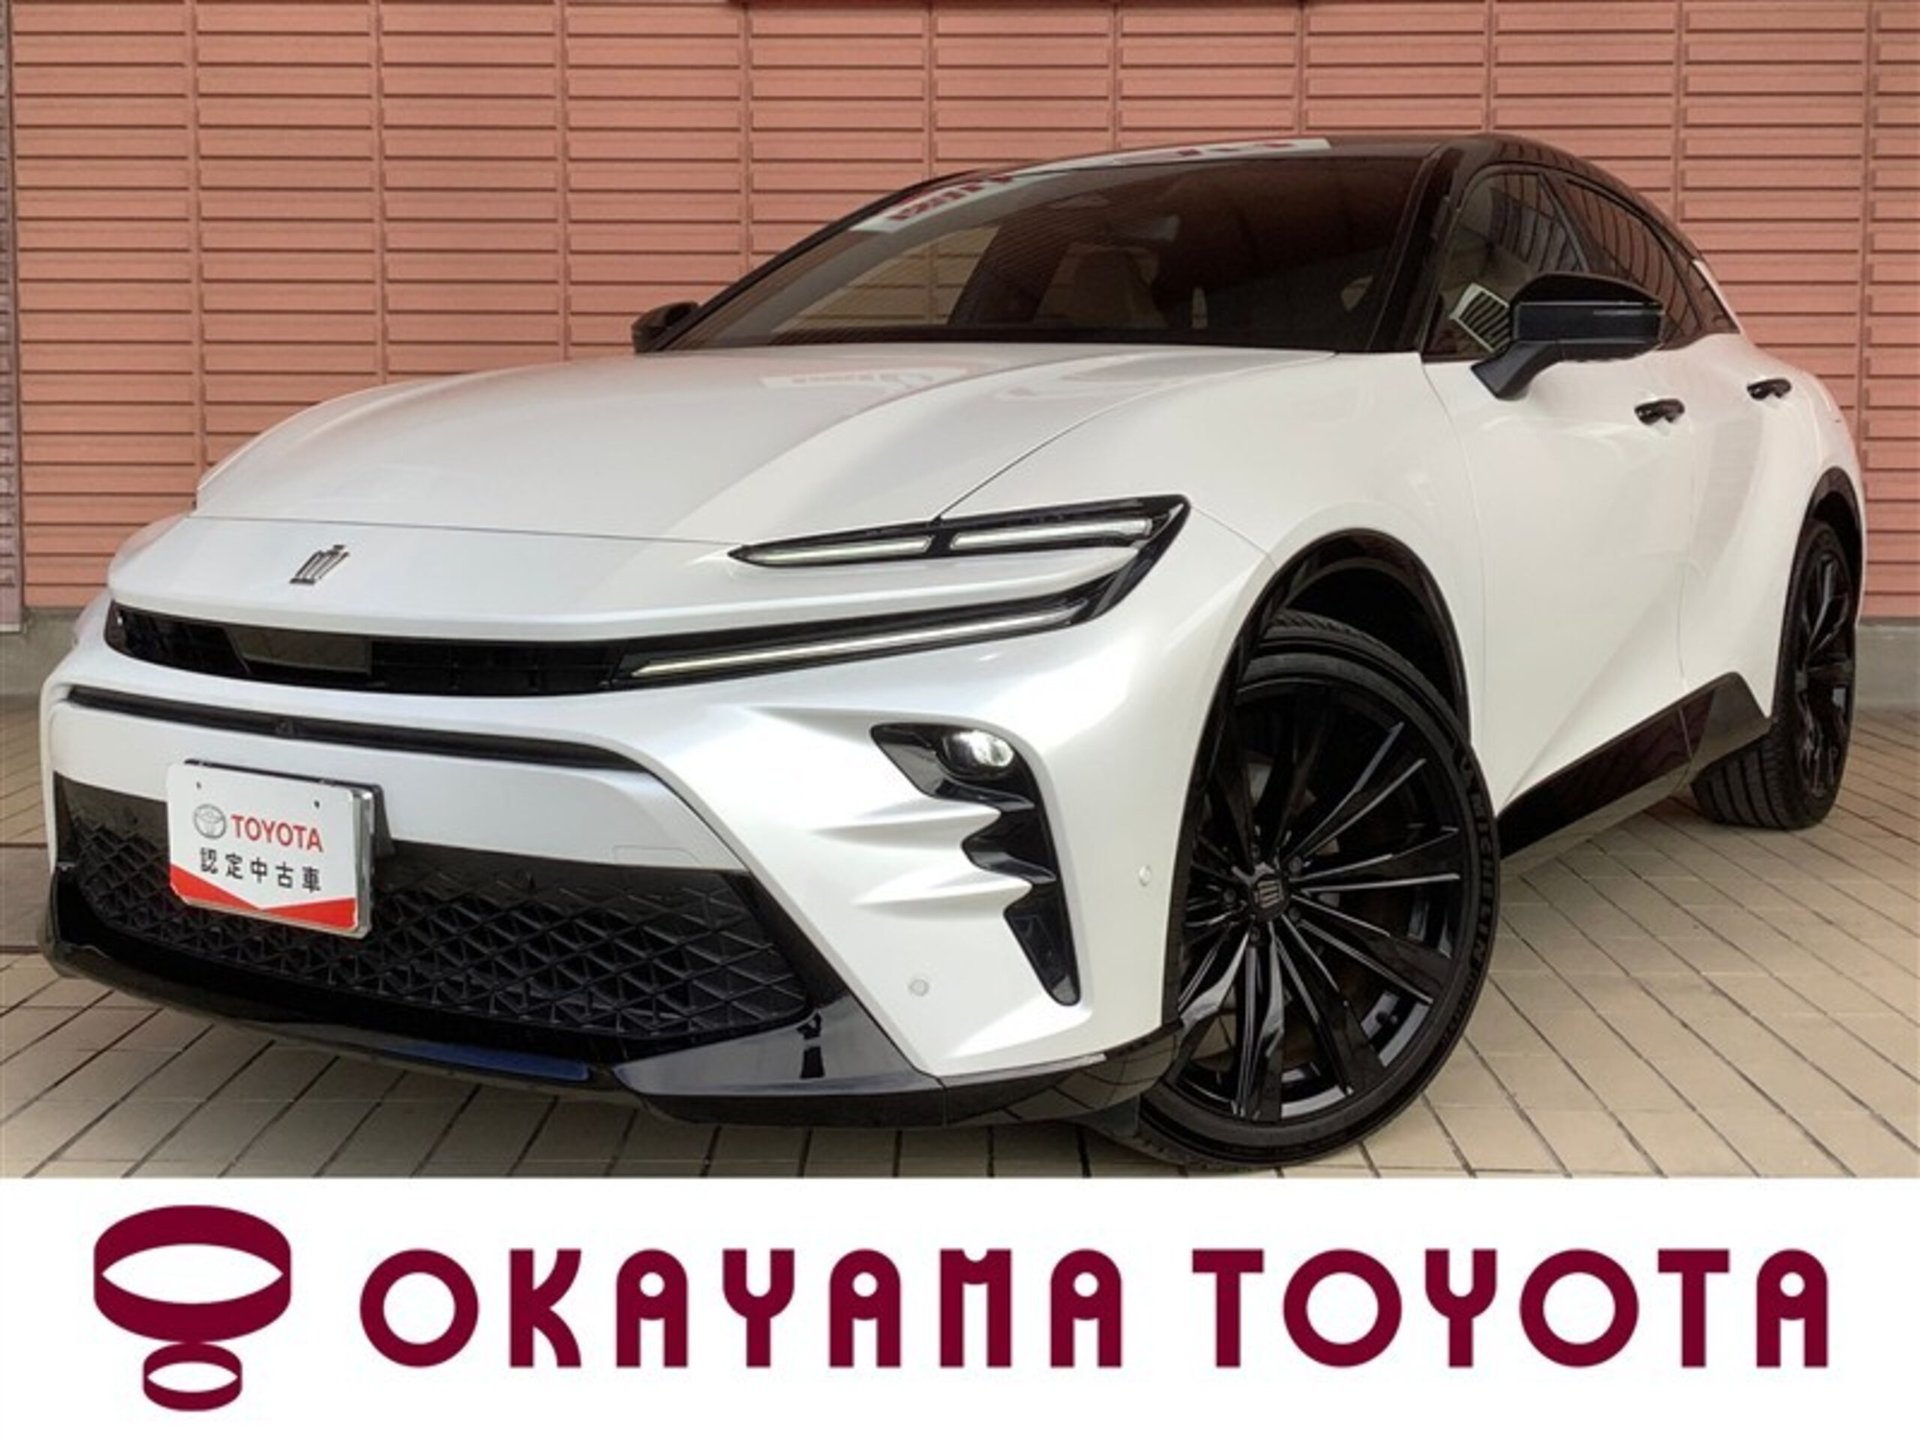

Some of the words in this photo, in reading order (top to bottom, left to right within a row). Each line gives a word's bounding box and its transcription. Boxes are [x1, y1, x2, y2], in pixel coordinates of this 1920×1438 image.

[231, 815, 323, 852] TOYOTA
[201, 848, 321, 892] 認定中古車
